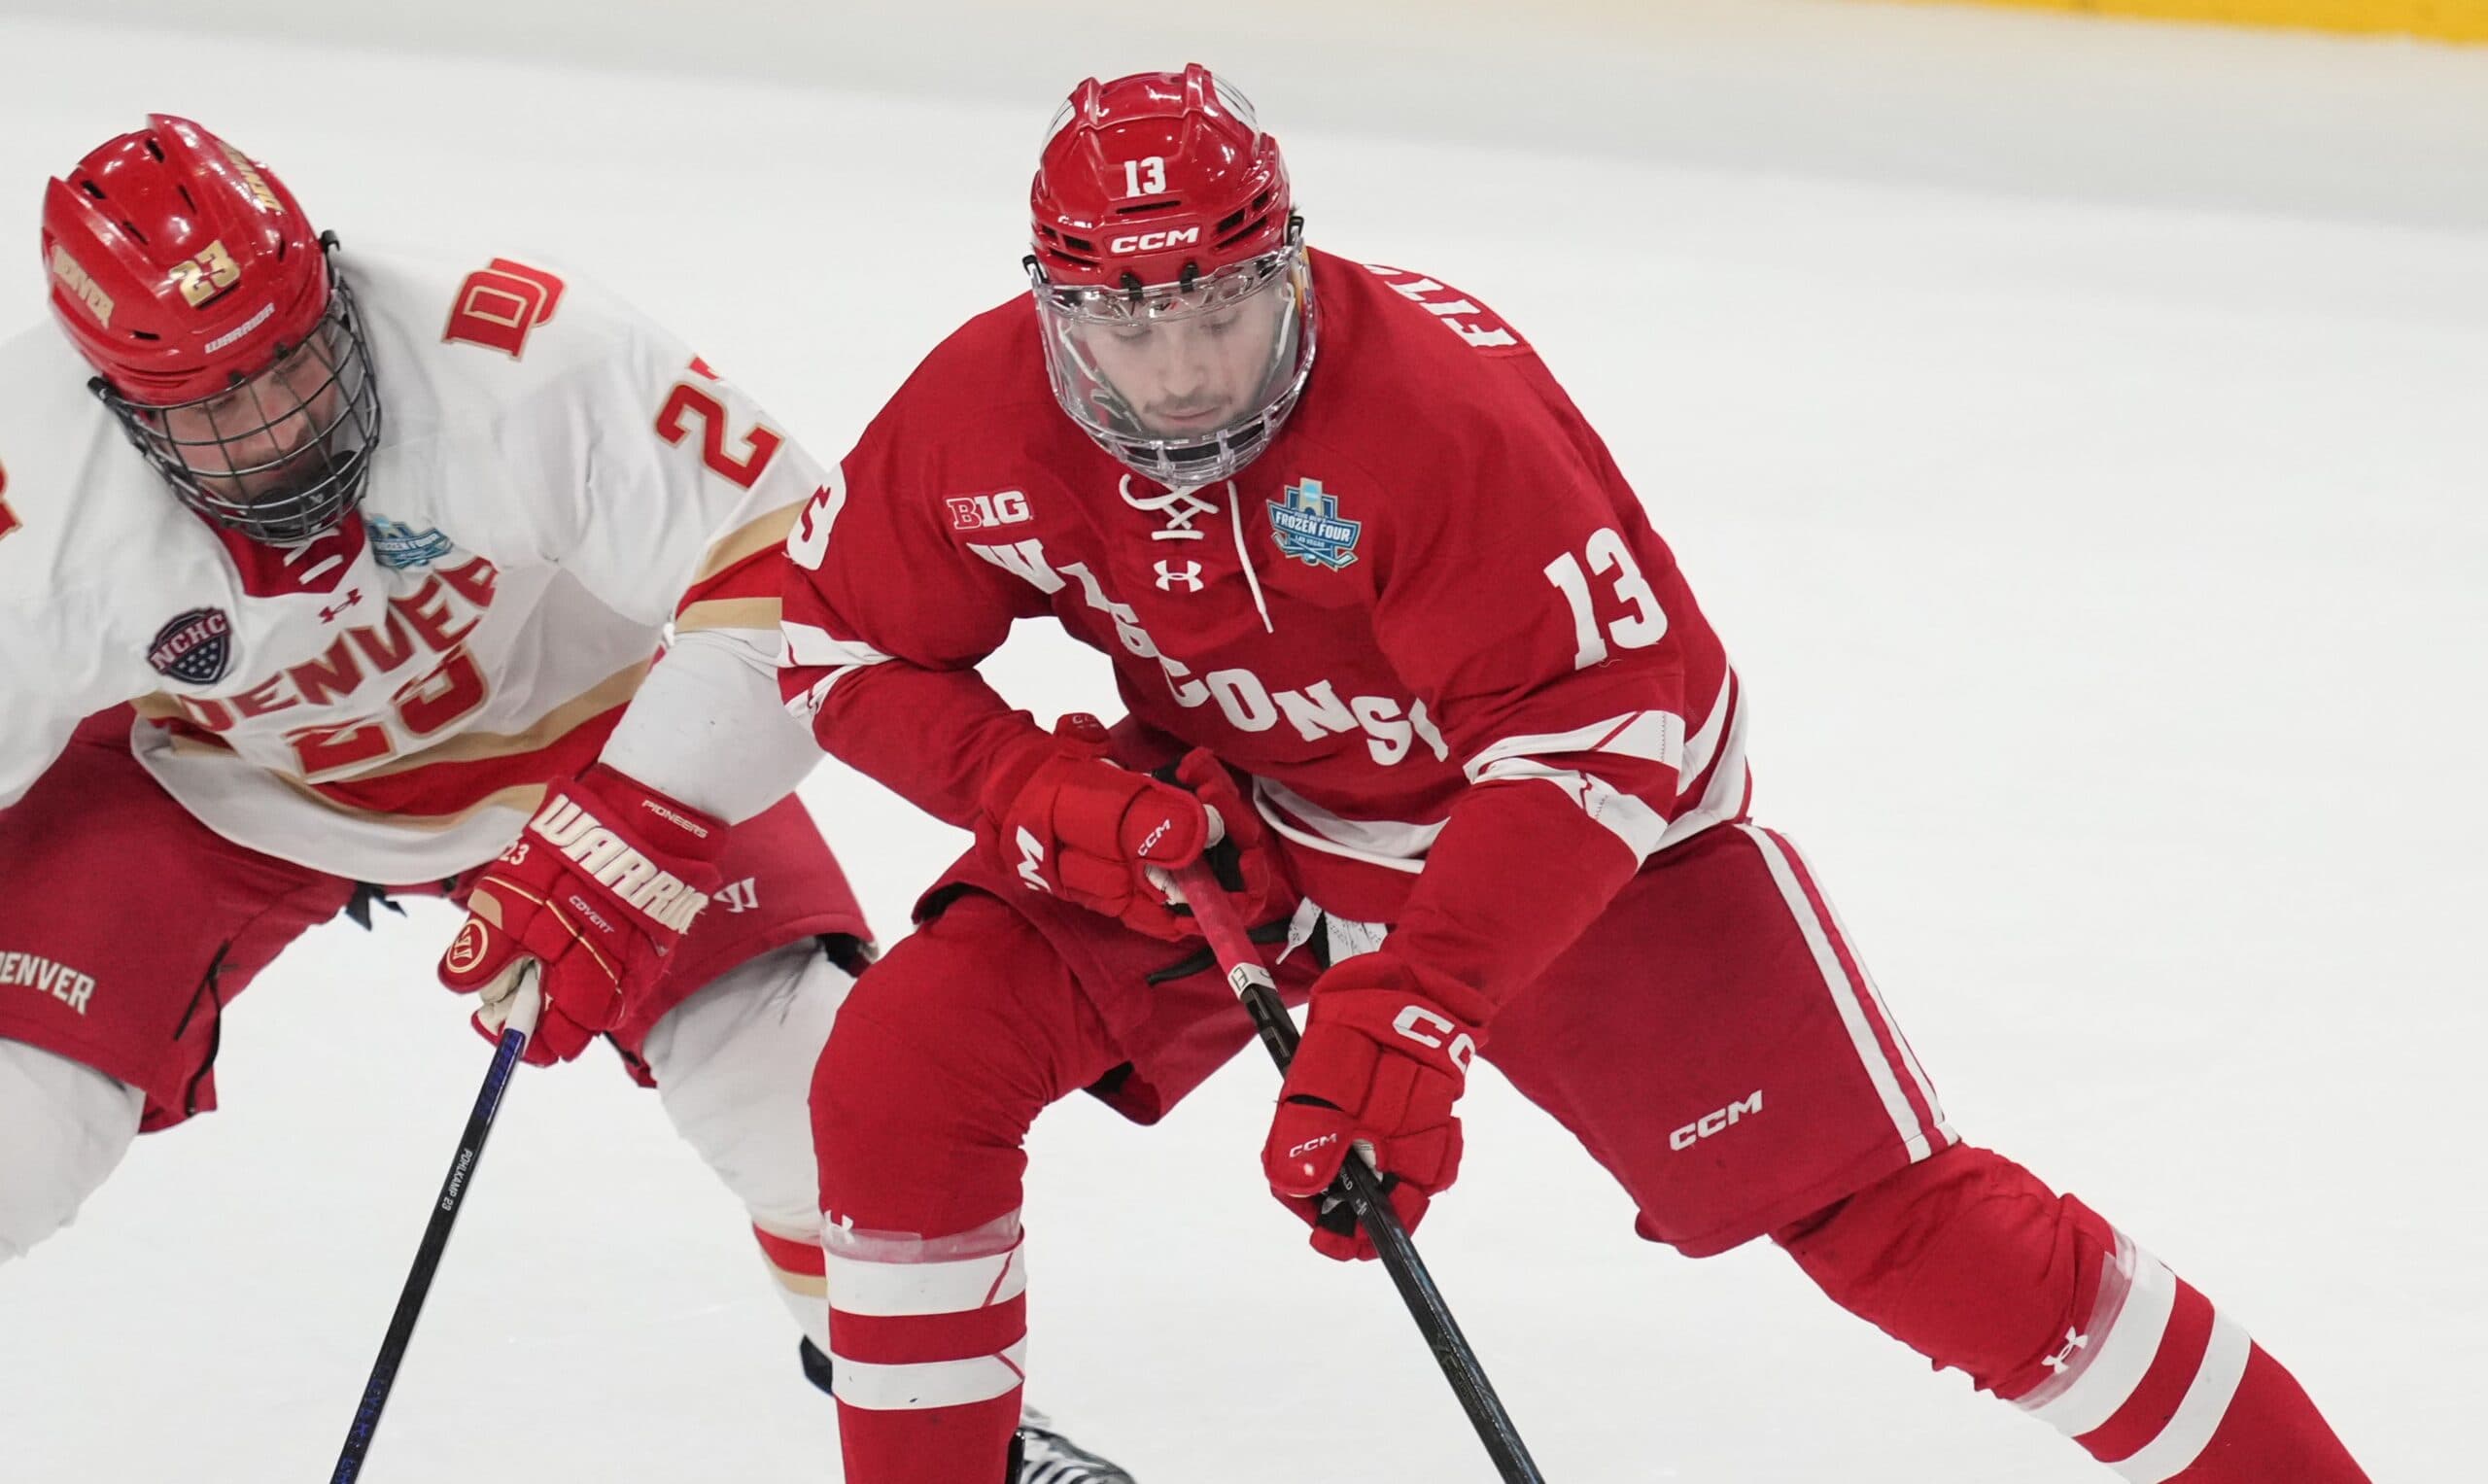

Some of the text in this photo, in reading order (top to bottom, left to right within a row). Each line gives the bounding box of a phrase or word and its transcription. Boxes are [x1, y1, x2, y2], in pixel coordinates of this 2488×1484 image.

[1123, 155, 1166, 198] 13
[1110, 226, 1199, 254] CCM
[168, 239, 241, 308] 23
[1362, 263, 1519, 348] FIT
[653, 353, 785, 491] 2
[1274, 510, 1318, 535] FROZEN
[1318, 524, 1351, 542] FOUR
[1543, 527, 1669, 672] 13
[150, 612, 225, 671] NCHC
[641, 799, 708, 839] PIONEERS
[1137, 818, 1171, 856] CCM
[568, 894, 615, 934] COVERT
[0, 950, 96, 1017] ENVER
[1668, 1088, 1764, 1152] CCM
[1289, 1132, 1338, 1158] CCM
[441, 1196, 455, 1212] 23
